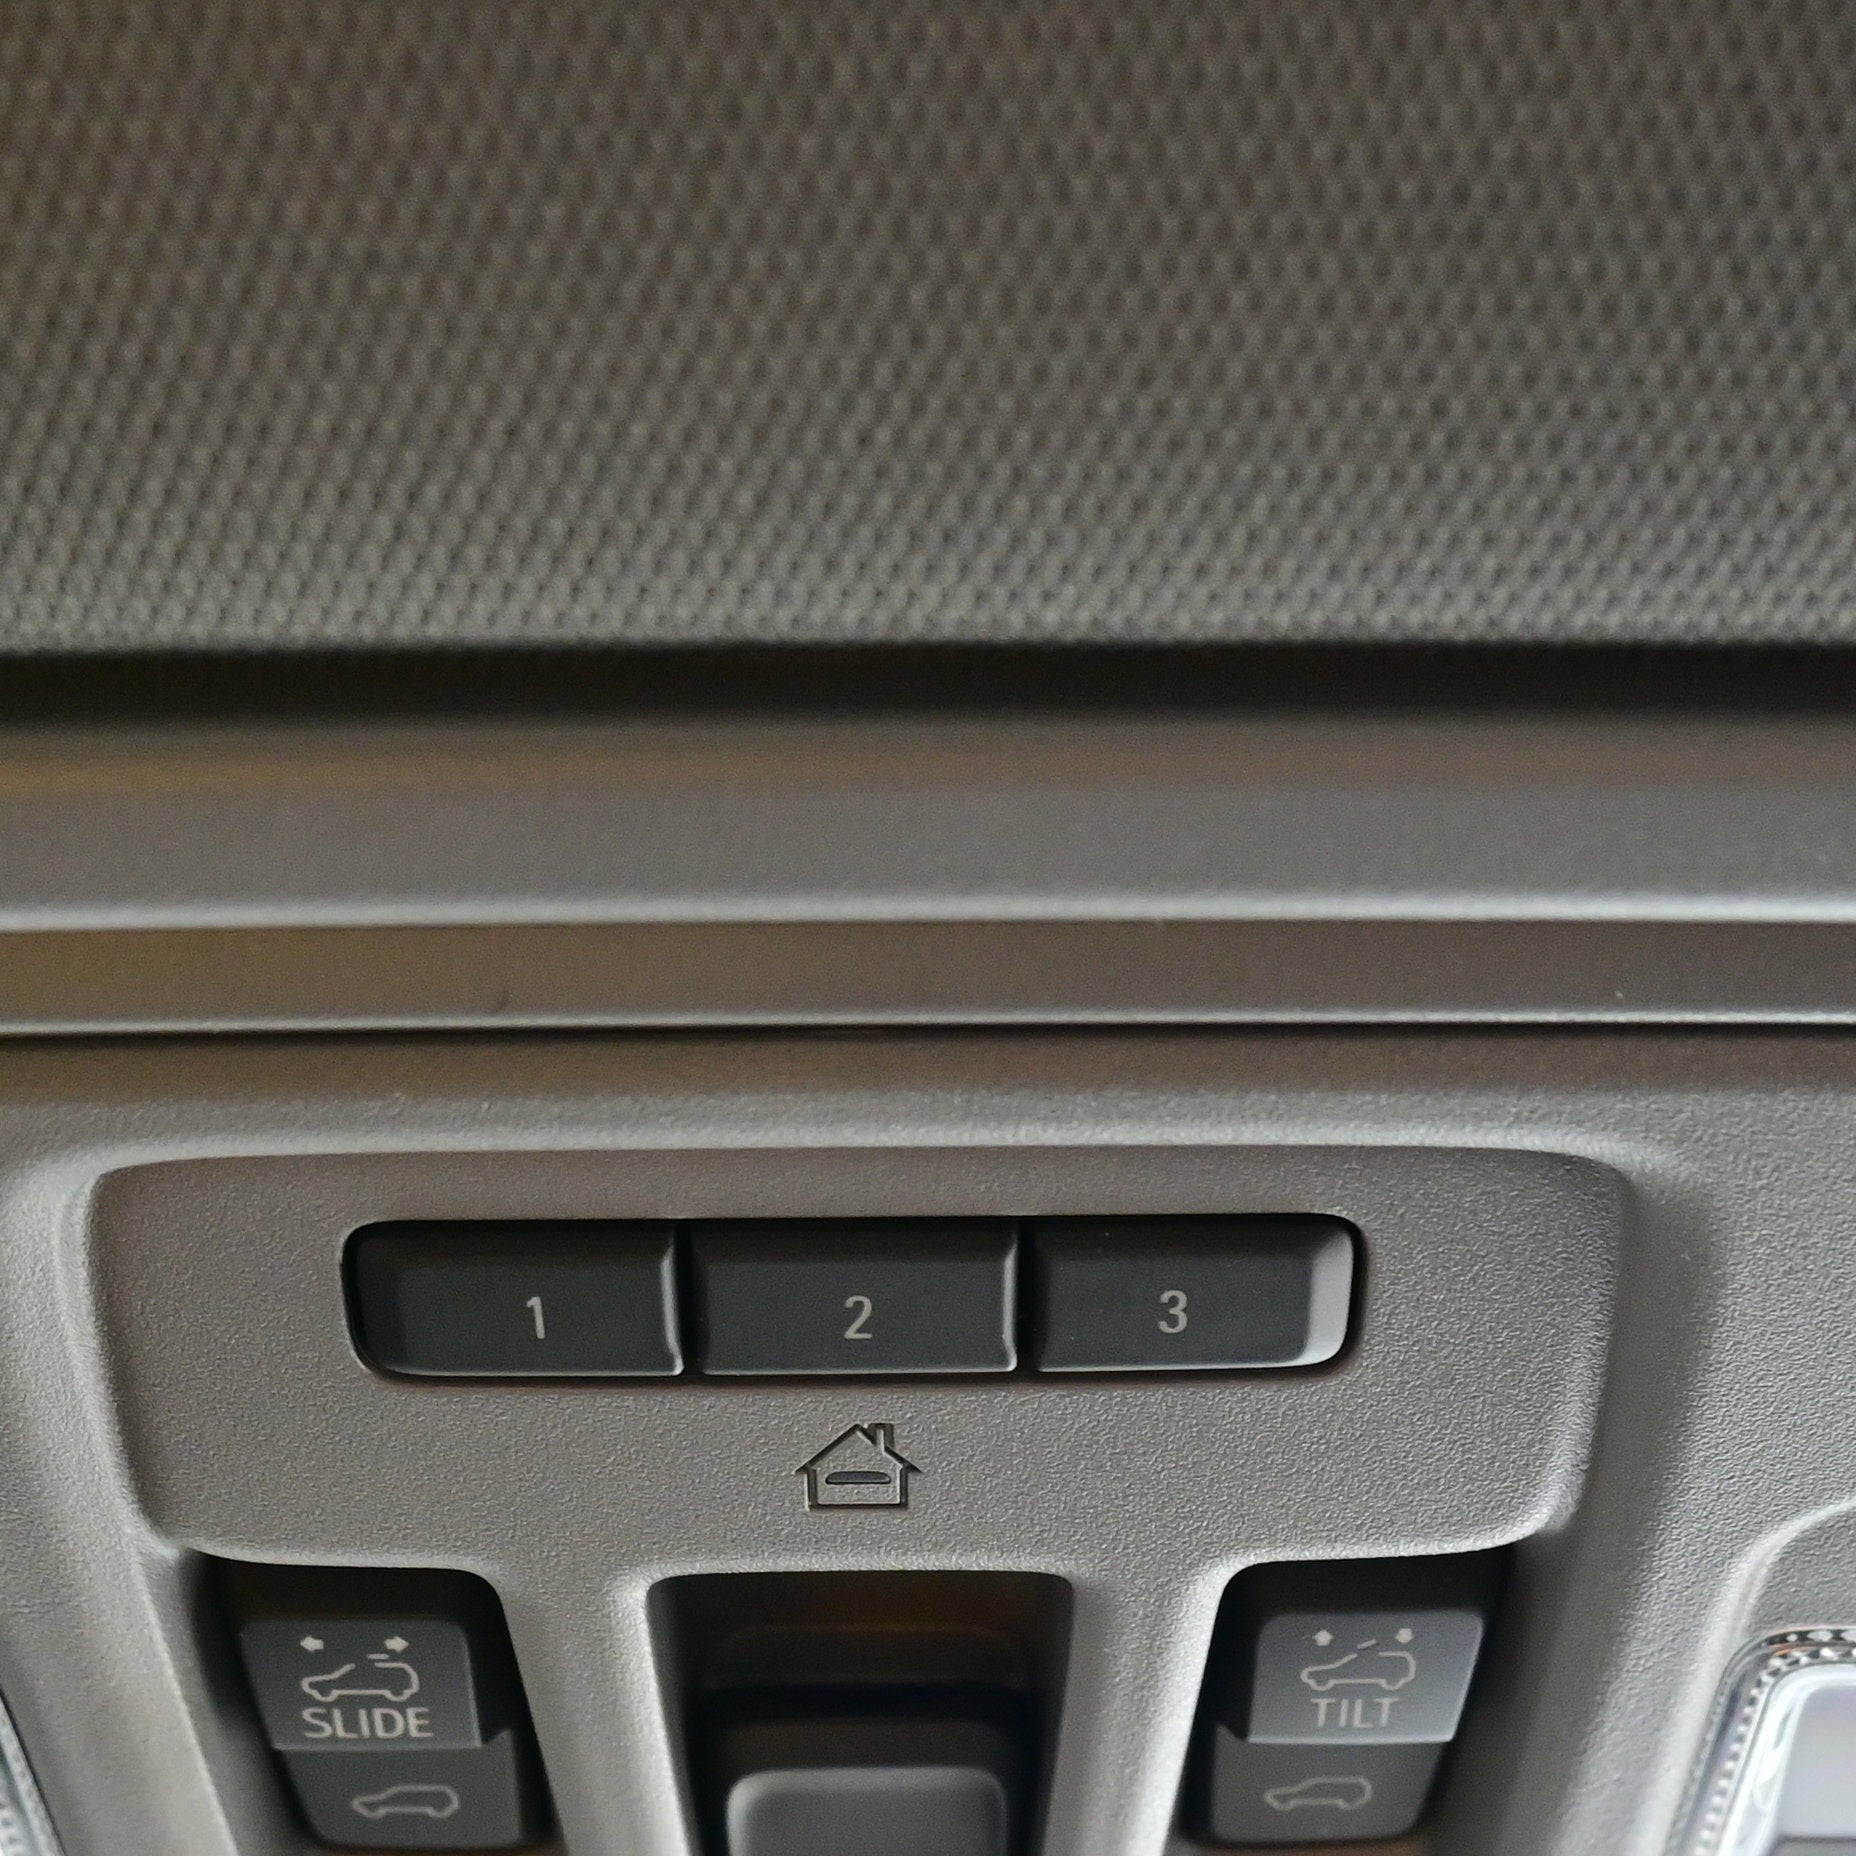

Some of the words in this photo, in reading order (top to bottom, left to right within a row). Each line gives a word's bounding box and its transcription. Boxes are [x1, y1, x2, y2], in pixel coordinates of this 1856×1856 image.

[526, 1296, 544, 1338] 1
[844, 1296, 874, 1340] 2
[1157, 1290, 1189, 1334] 3
[302, 1707, 433, 1739] SLIDE
[1310, 1698, 1399, 1728] TILT
